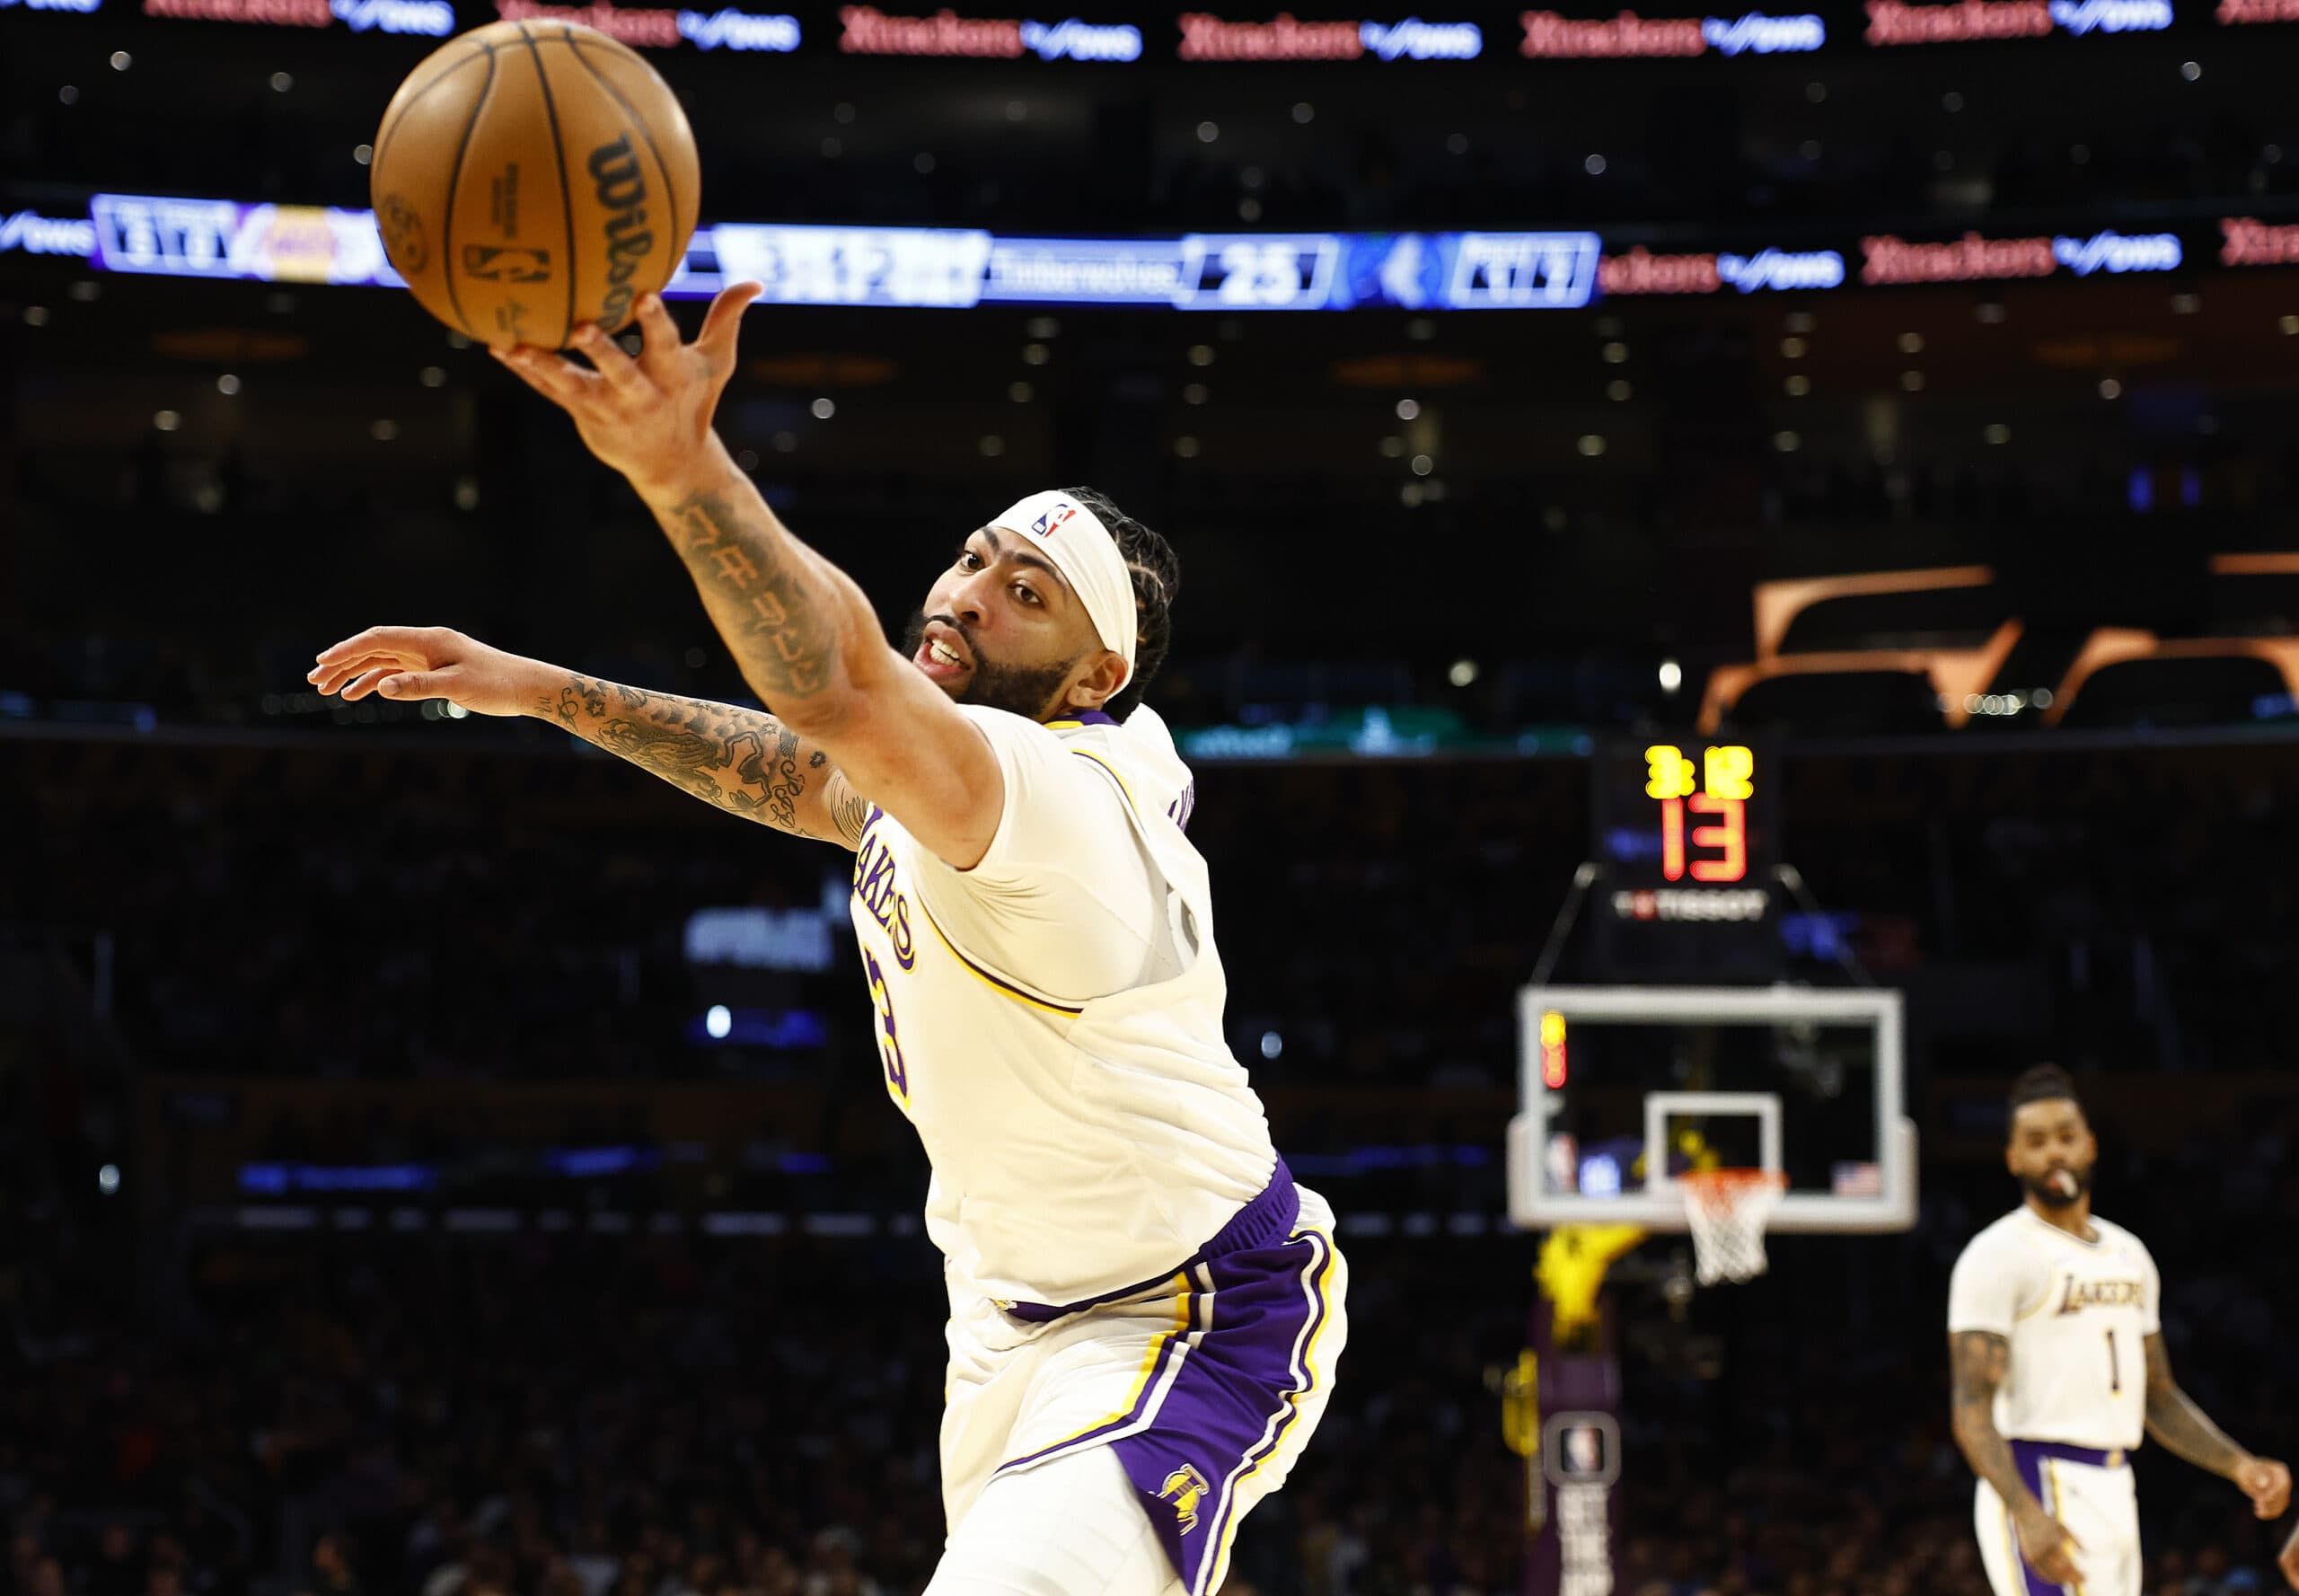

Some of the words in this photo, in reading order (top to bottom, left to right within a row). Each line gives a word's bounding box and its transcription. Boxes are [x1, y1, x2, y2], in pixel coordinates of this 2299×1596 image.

[1219, 241, 1301, 305] 25
[1660, 791, 1748, 883] 13
[2103, 1327, 2121, 1398] 1
